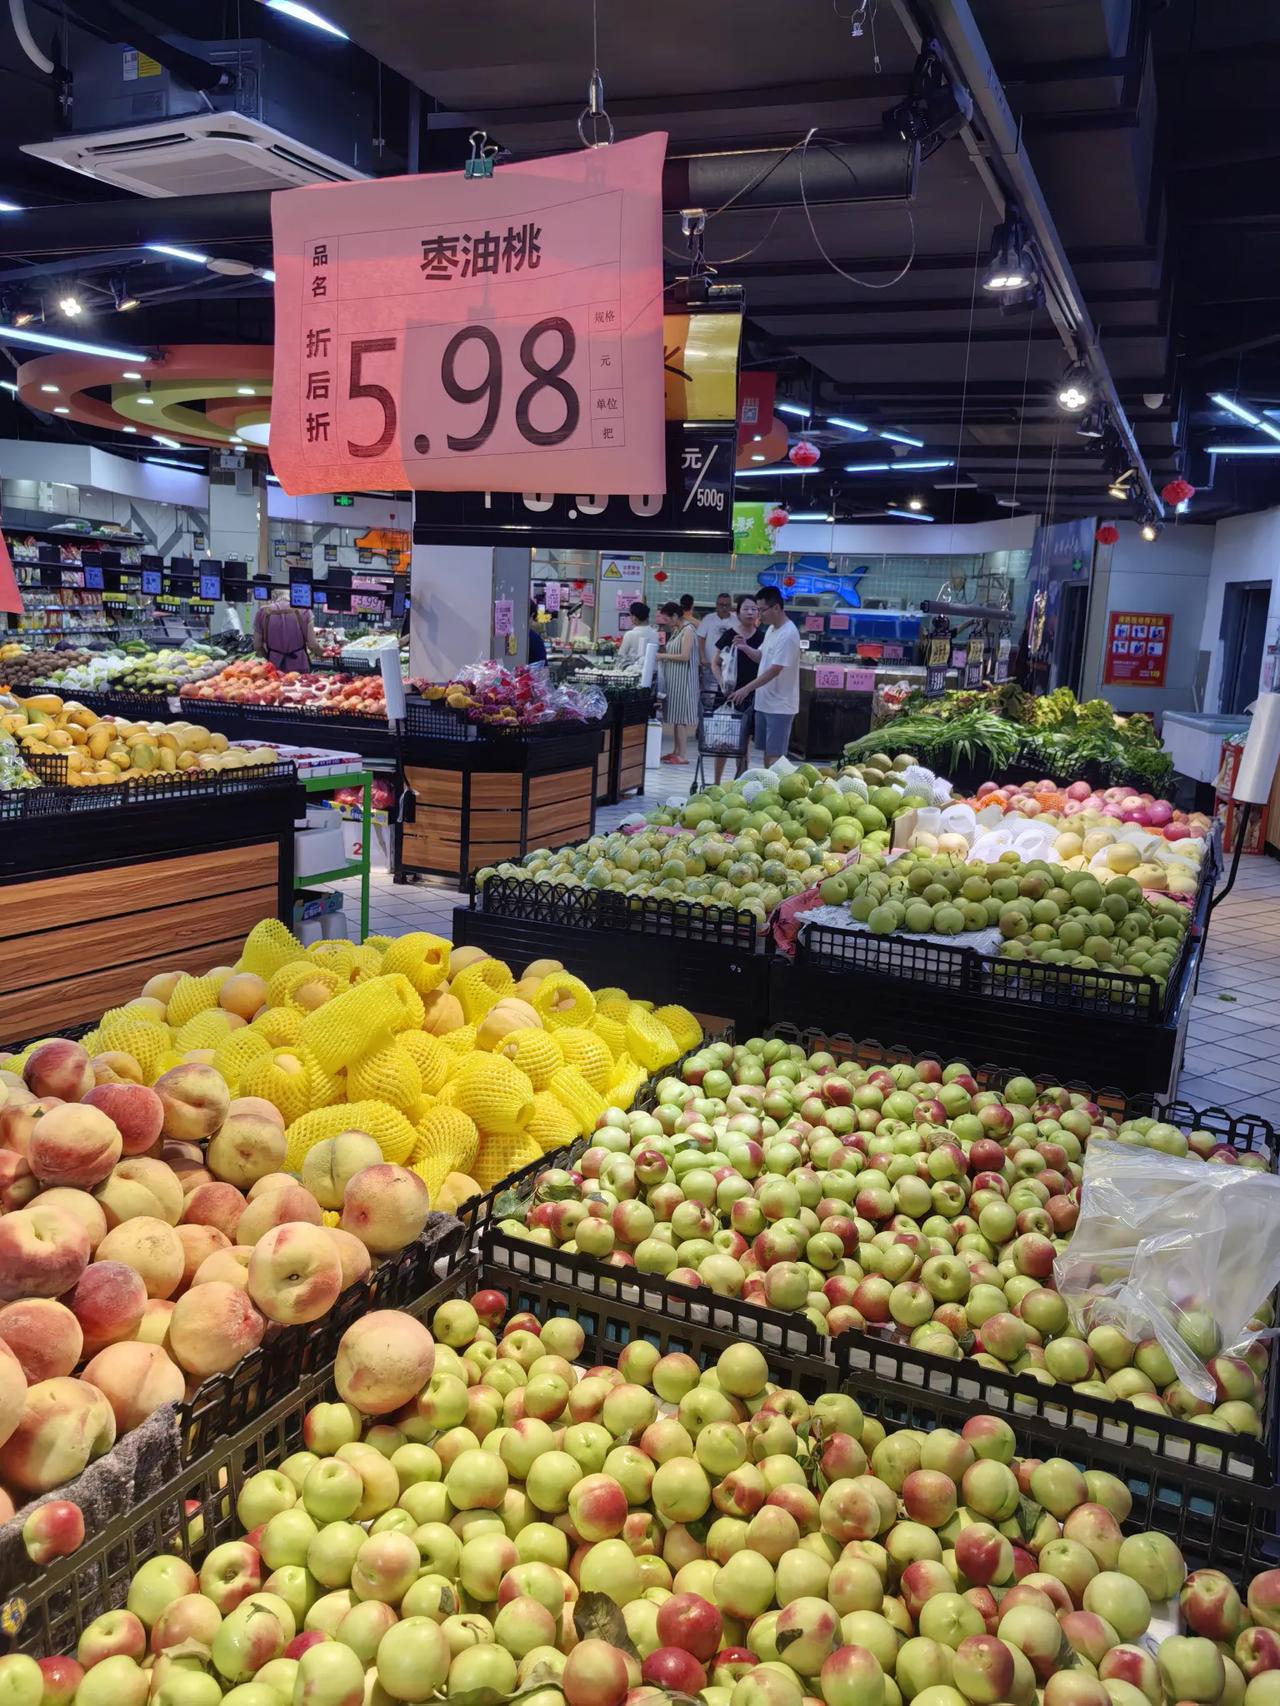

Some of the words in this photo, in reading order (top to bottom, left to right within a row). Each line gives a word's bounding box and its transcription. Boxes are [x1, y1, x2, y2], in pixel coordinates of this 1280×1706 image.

[420, 222, 542, 281] 枣油桃
[311, 244, 329, 298] 品名
[594, 310, 616, 324] 规格
[599, 354, 612, 367] 元
[347, 316, 580, 458] 5.98
[596, 397, 618, 411] 单位
